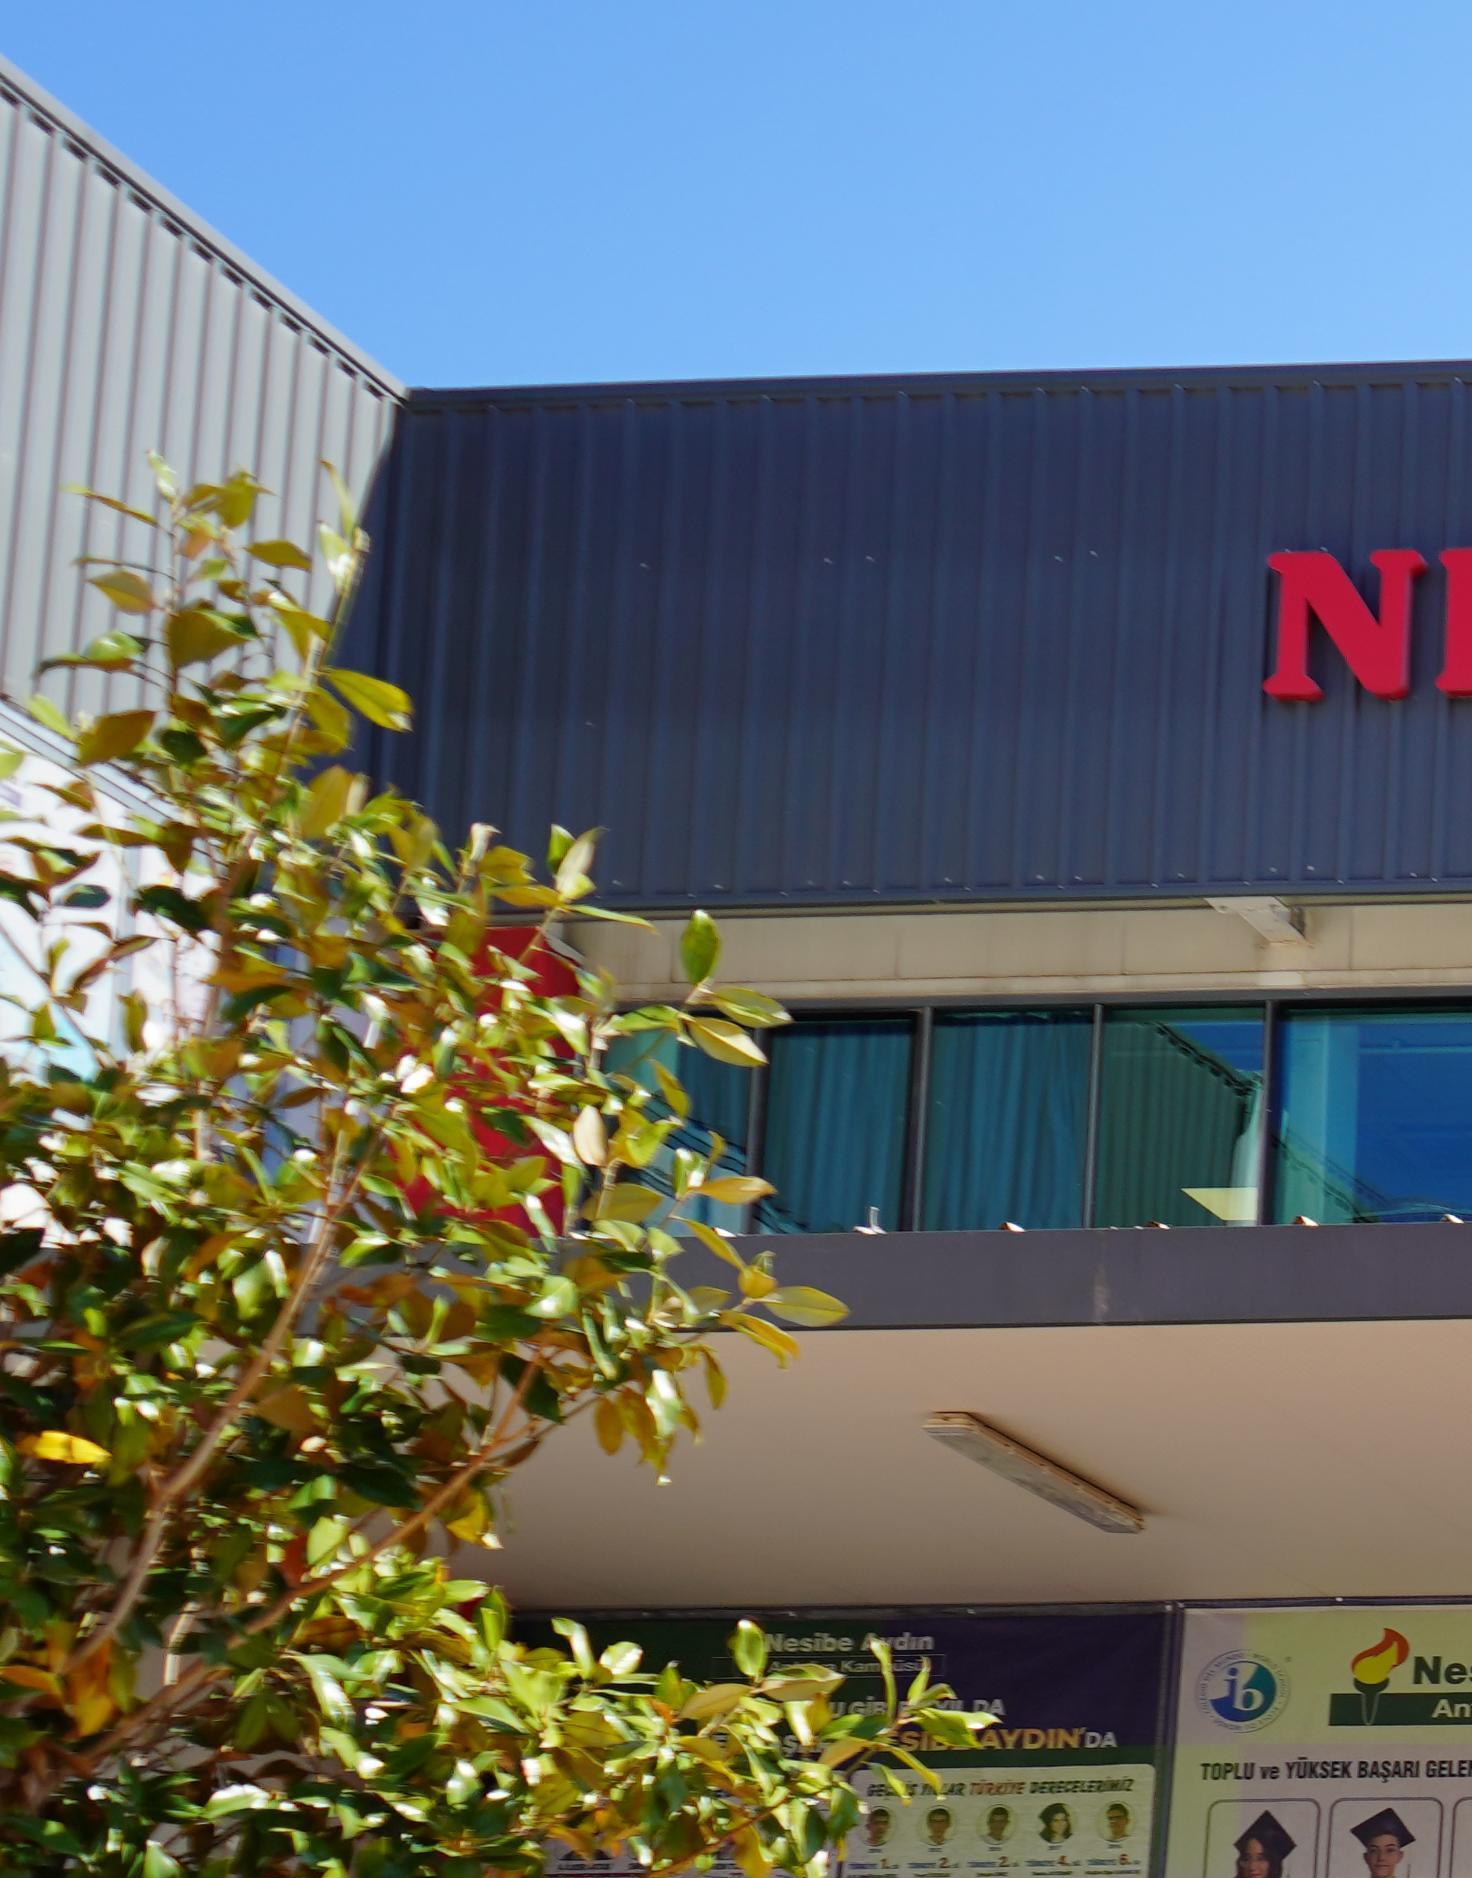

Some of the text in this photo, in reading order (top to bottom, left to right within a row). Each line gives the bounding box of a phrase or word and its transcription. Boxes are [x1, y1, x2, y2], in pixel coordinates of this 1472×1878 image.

[1200, 1762, 1256, 1781] TOPLU
[1258, 1766, 1280, 1780] ve
[1285, 1756, 1354, 1780] YÜKSEK
[1357, 1759, 1420, 1784] BAŞARI
